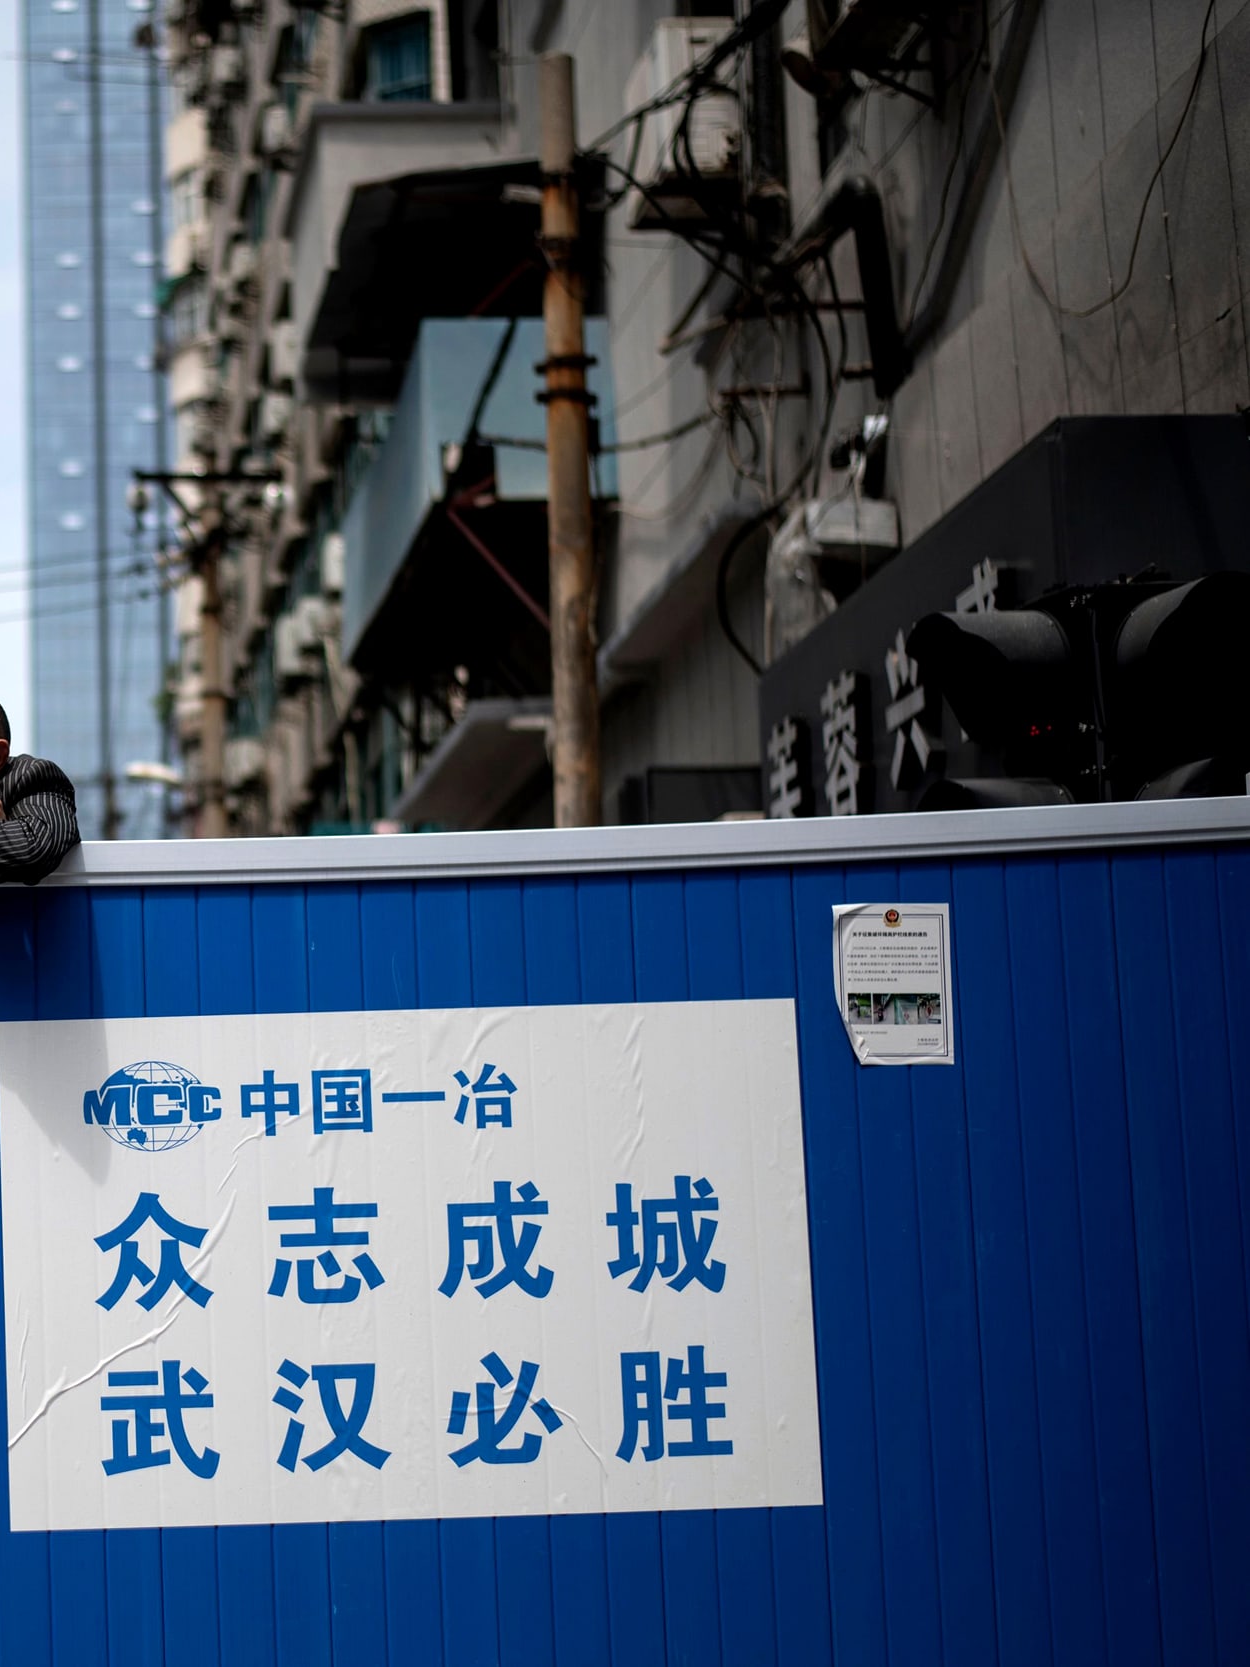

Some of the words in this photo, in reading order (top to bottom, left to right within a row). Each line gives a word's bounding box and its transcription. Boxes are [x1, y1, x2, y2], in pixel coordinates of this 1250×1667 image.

[83, 1082, 222, 1127] MCC
[241, 1064, 517, 1136] 中国一冶
[94, 1176, 726, 1311] 众志成城
[101, 1345, 733, 1479] 武汉必胜
